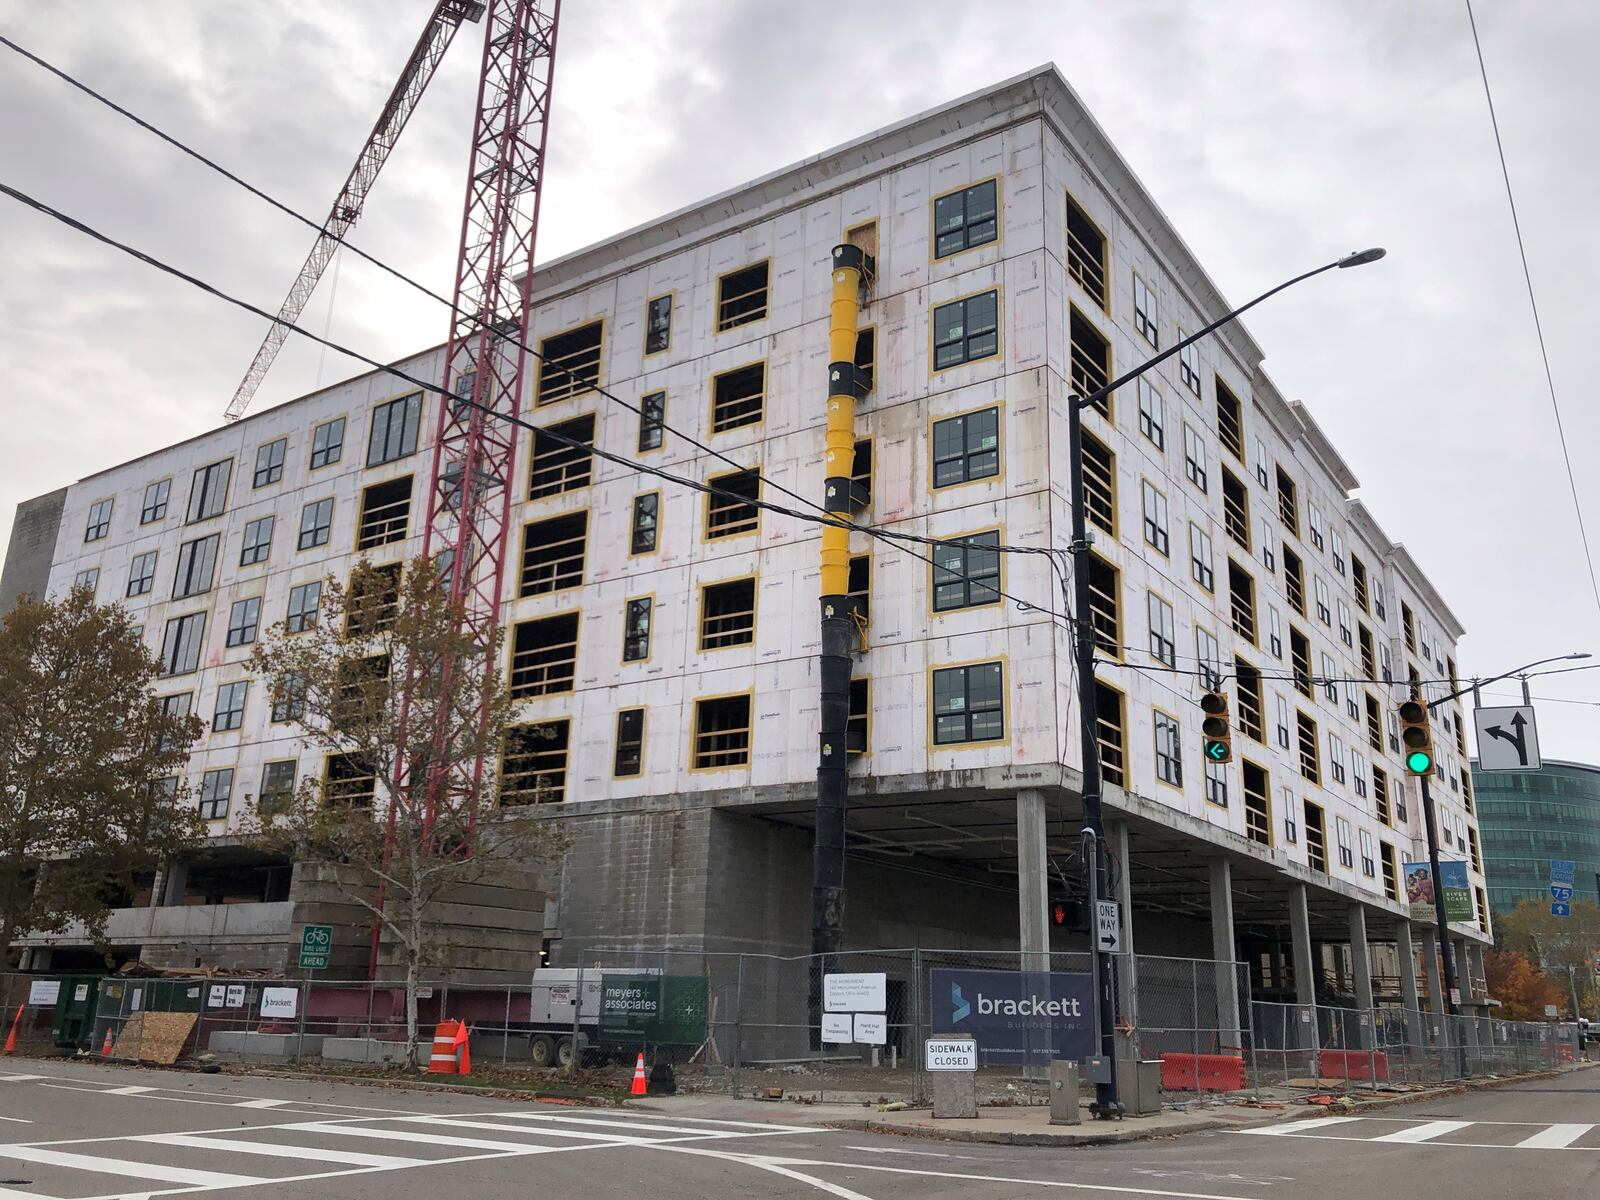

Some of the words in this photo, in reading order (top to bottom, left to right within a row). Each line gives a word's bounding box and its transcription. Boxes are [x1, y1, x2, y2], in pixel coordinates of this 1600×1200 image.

[1553, 887, 1570, 899] 75
[1099, 904, 1116, 918] ONE
[1099, 918, 1116, 931] WAY
[303, 956, 325, 966] AHEAD
[269, 998, 292, 1007] brackett
[605, 998, 657, 1010] associates
[977, 993, 1082, 1017] brackett
[929, 1045, 973, 1054] SIDEWALK
[934, 1057, 969, 1066] CLOSED
